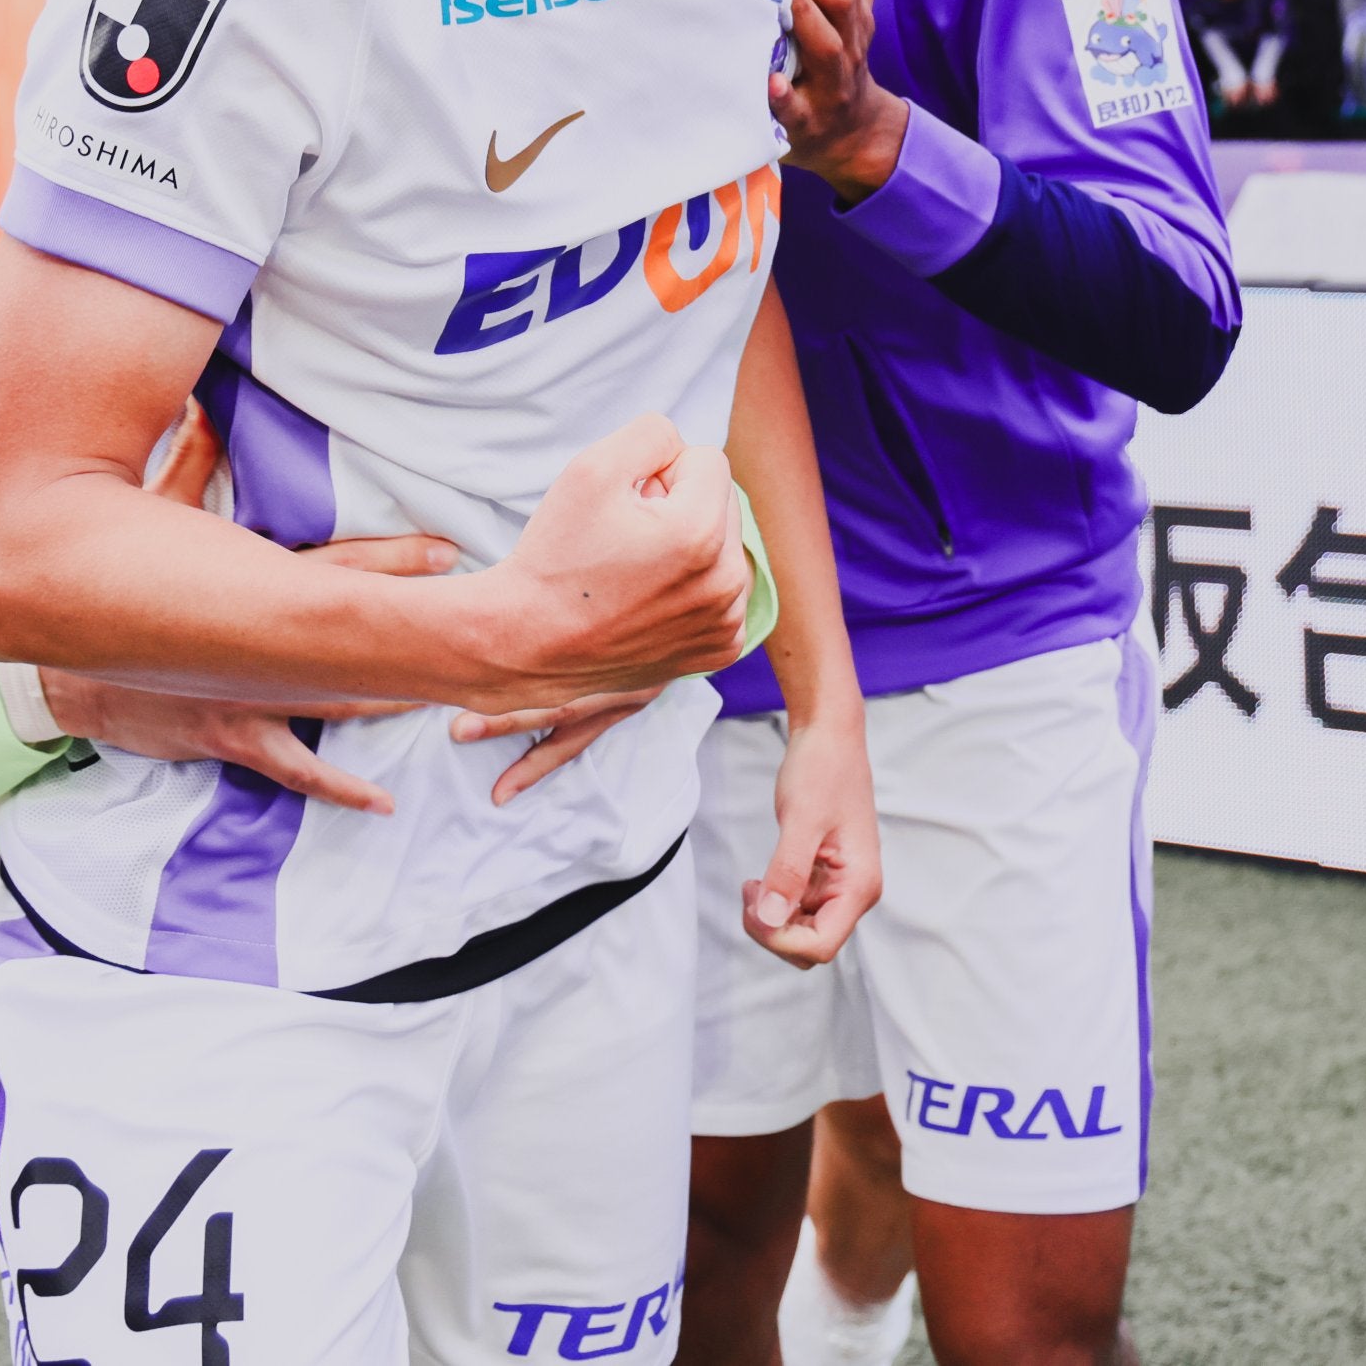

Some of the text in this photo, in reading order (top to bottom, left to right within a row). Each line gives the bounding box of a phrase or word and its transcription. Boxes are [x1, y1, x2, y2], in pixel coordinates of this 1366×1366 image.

[1097, 86, 1187, 122] 良和ハウス
[33, 105, 178, 190] HIROSHIMA
[905, 1070, 1123, 1141] TERAL
[11, 1149, 244, 1366] 24
[494, 1257, 686, 1361] TER
